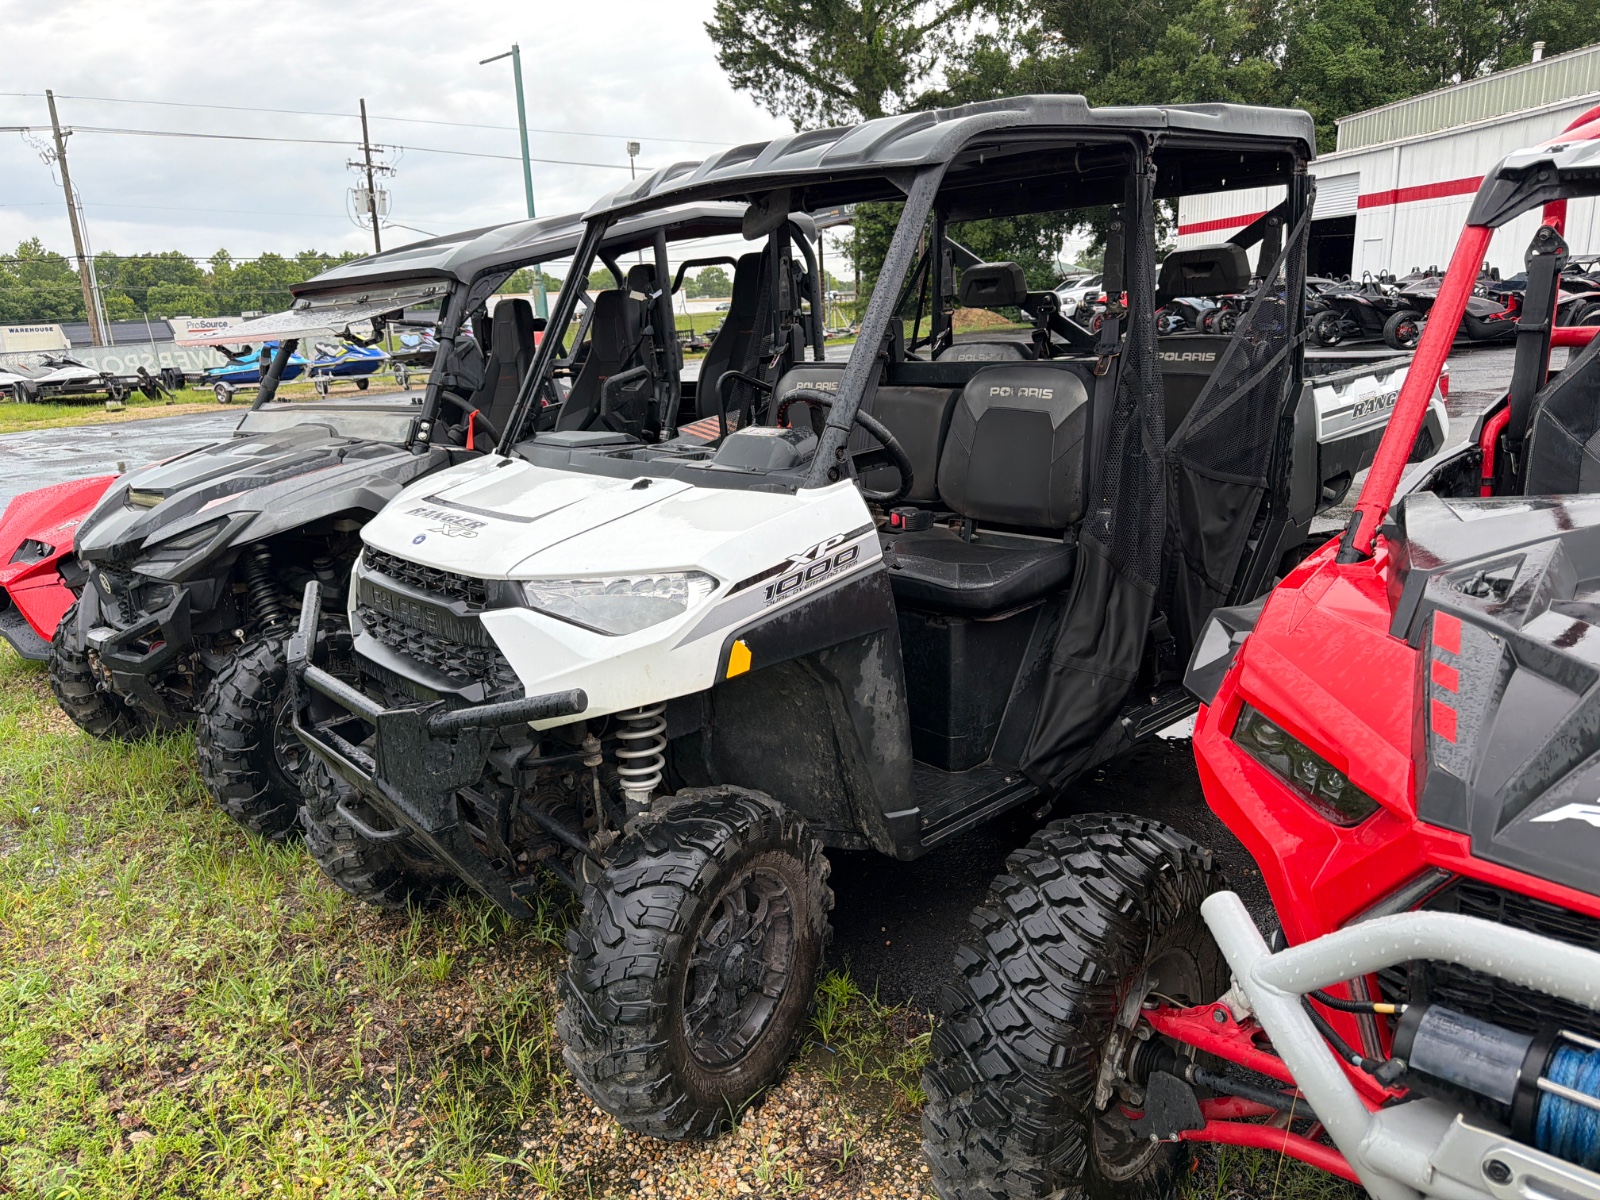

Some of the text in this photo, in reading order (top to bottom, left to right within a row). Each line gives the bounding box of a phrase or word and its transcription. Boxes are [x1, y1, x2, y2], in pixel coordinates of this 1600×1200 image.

[187, 320, 228, 329] ProSource
[1157, 352, 1217, 362] POLARIS
[796, 381, 839, 391] POLARIS
[1351, 391, 1399, 420] RANG
[404, 507, 488, 531] RANGER
[426, 523, 479, 538] XP
[777, 533, 846, 578] XP
[764, 543, 860, 603] 1000
[765, 560, 858, 608] DUAL OVERHEAD CAM
